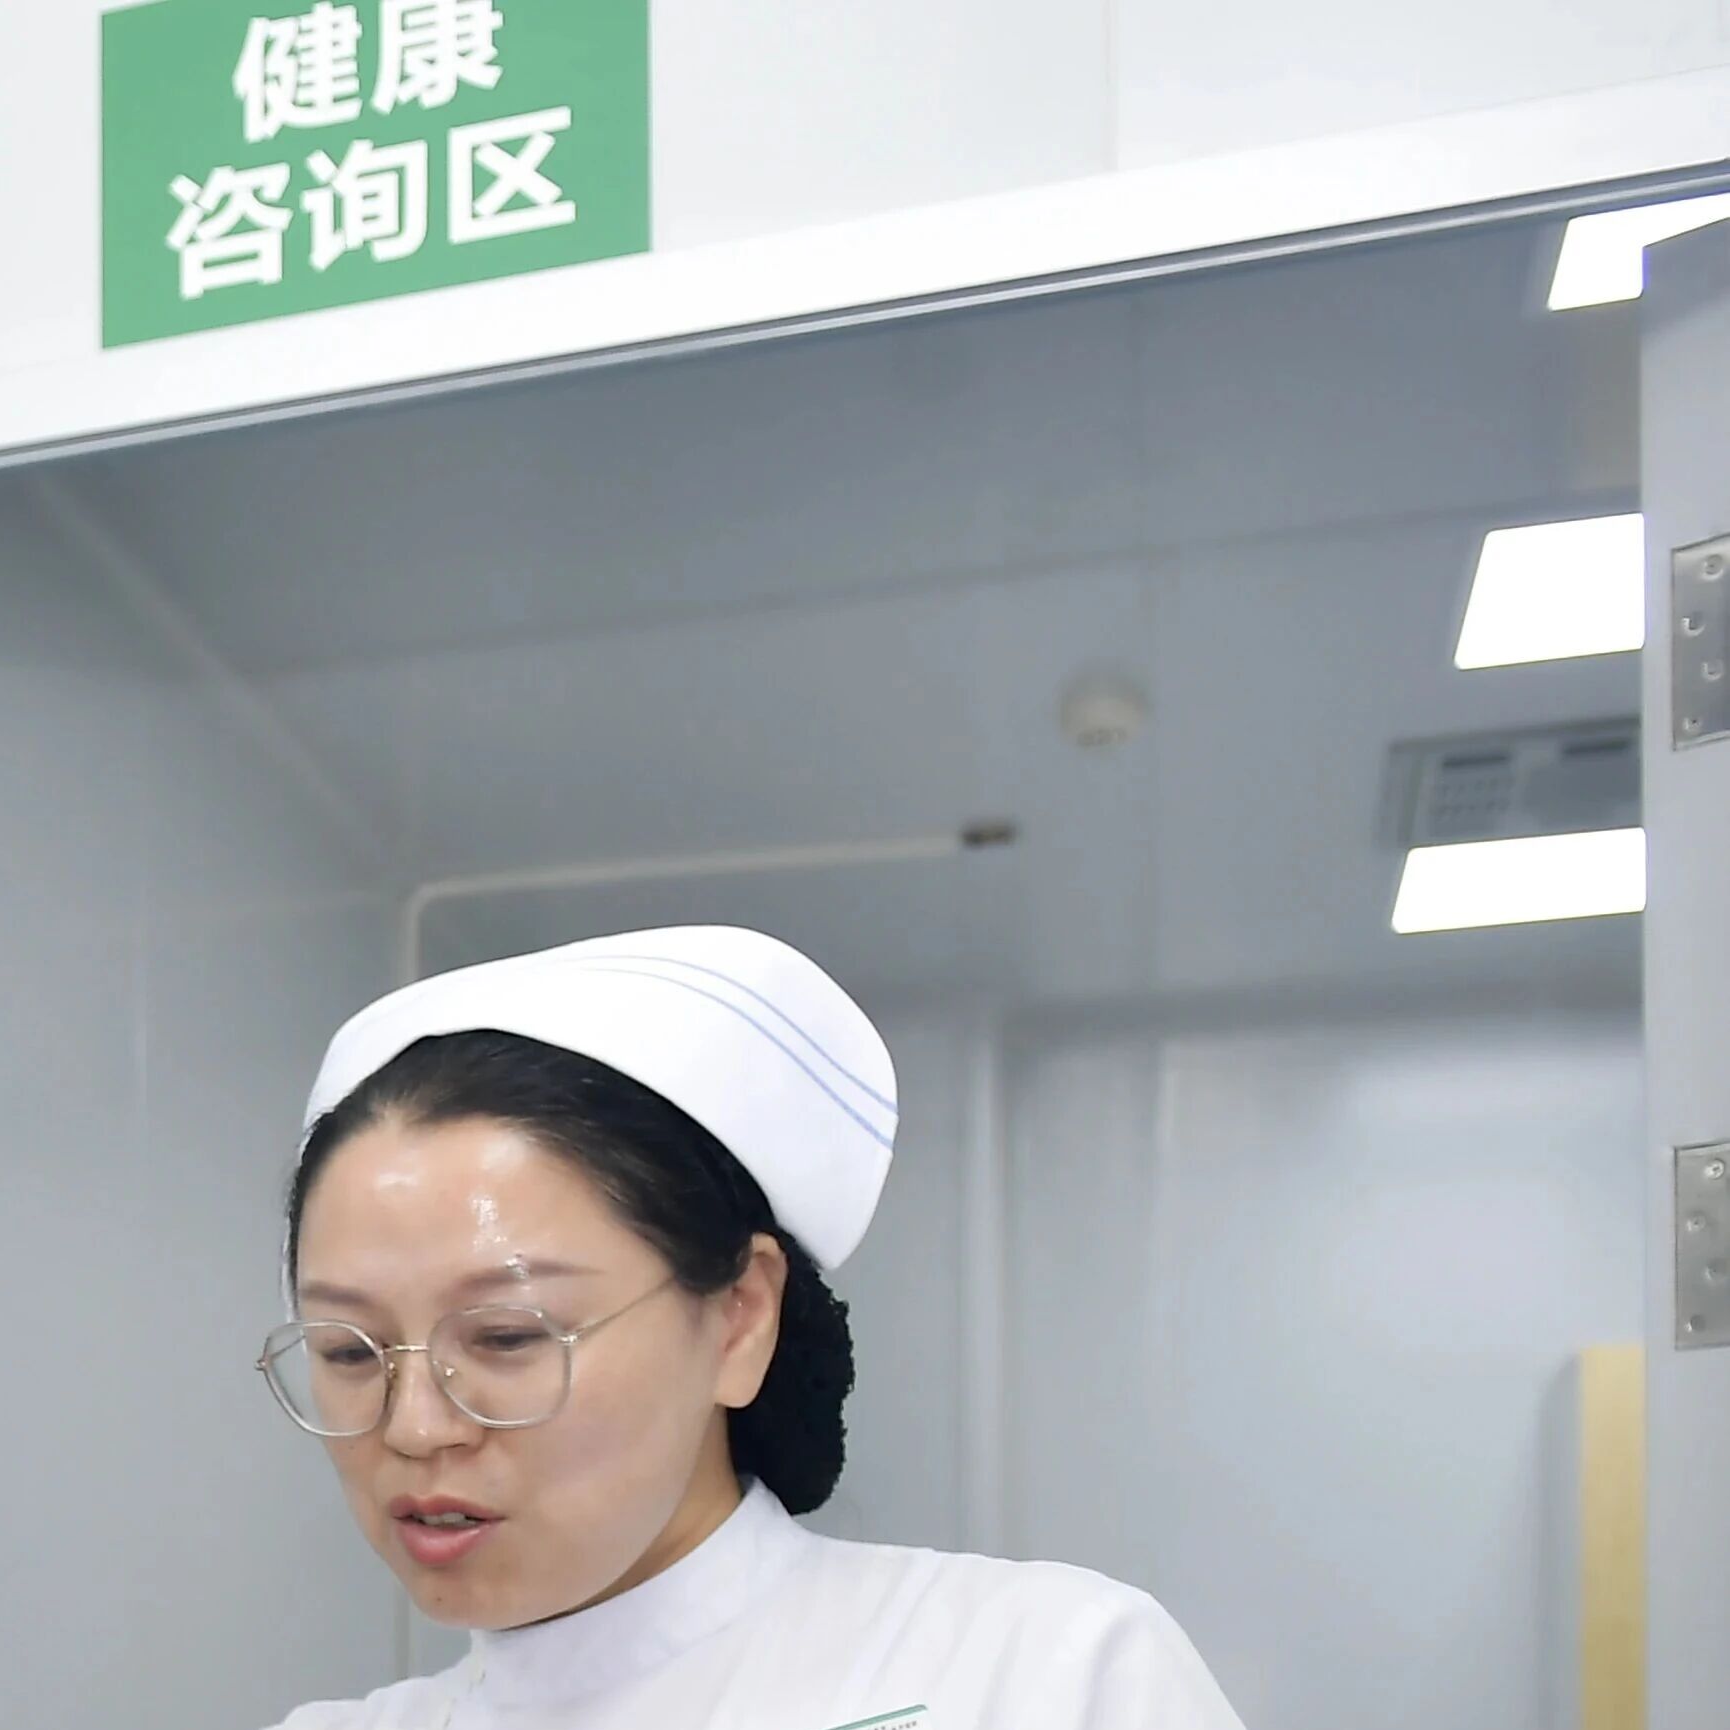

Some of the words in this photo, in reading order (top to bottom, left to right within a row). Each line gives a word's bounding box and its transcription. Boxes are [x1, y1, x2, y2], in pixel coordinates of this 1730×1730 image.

[233, 0, 505, 143] 健康
[165, 107, 577, 300] 咨询区
